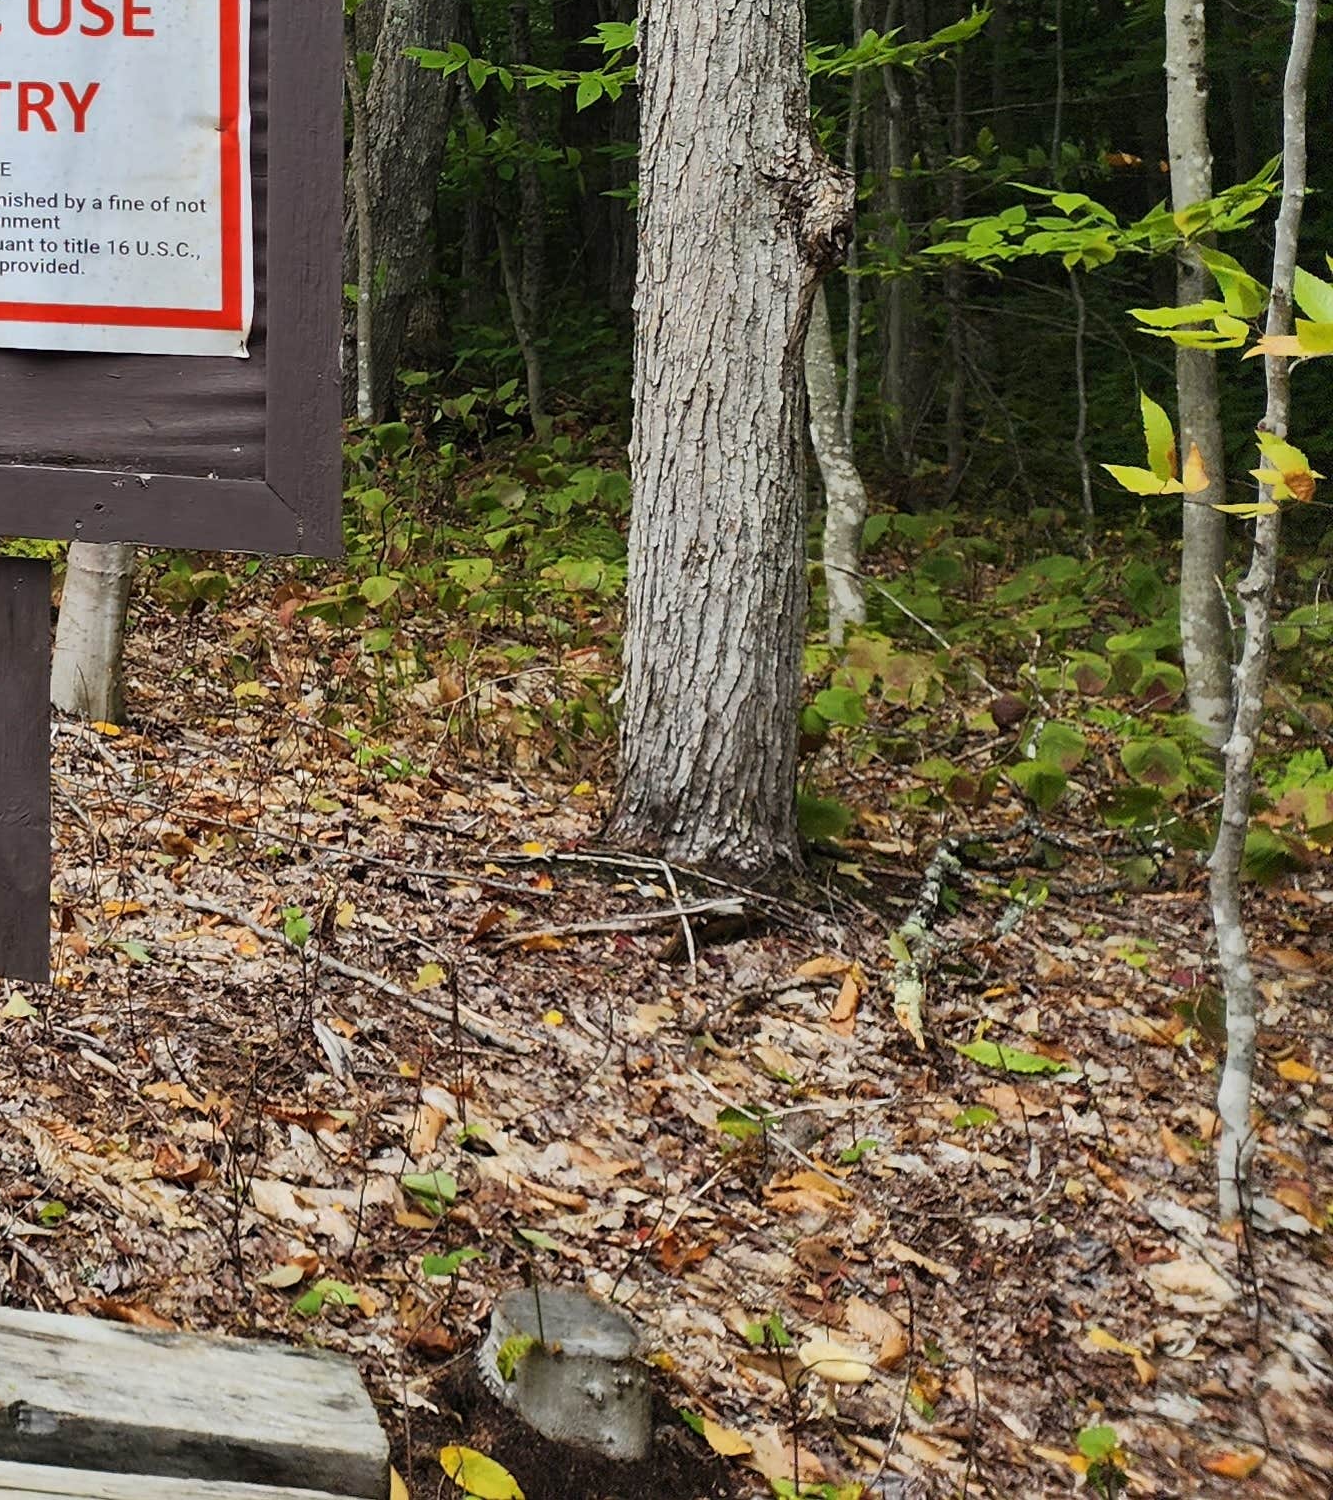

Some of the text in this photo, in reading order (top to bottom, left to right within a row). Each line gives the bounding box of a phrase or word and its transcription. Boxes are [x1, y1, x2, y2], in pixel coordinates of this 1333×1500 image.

[65, 193, 85, 213] by
[93, 198, 102, 209] a
[109, 195, 144, 211] fine
[151, 196, 170, 211] of
[176, 199, 206, 212] not
[39, 238, 58, 252] to
[63, 238, 100, 254] title
[108, 240, 129, 255] 16
[137, 241, 200, 260] U.S.C.,
[0, 258, 84, 276] provided.
